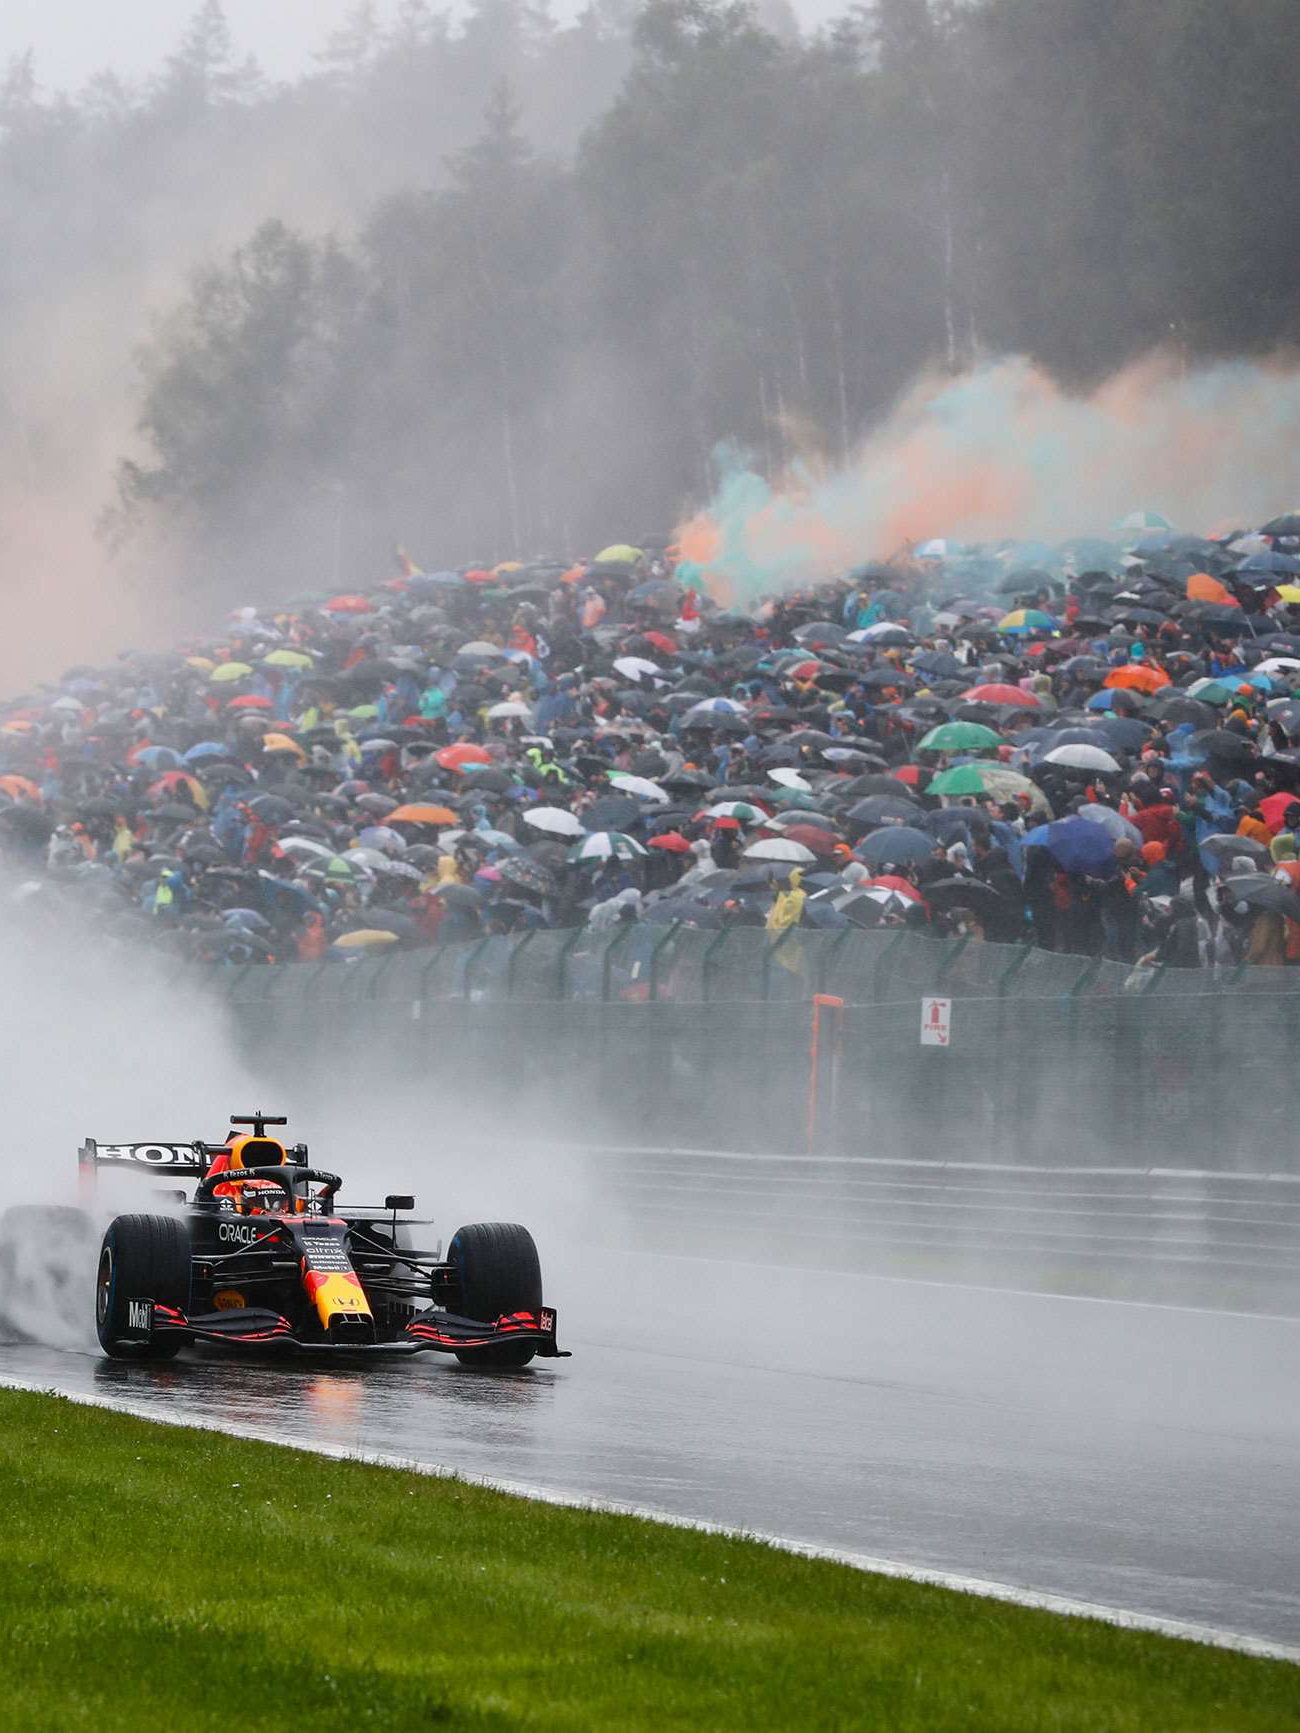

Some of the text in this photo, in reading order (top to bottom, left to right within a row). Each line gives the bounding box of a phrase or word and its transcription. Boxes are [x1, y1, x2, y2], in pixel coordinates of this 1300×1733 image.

[96, 1145, 211, 1164] HON
[219, 1223, 257, 1244] ORACLE
[128, 1301, 148, 1329] Mobil
